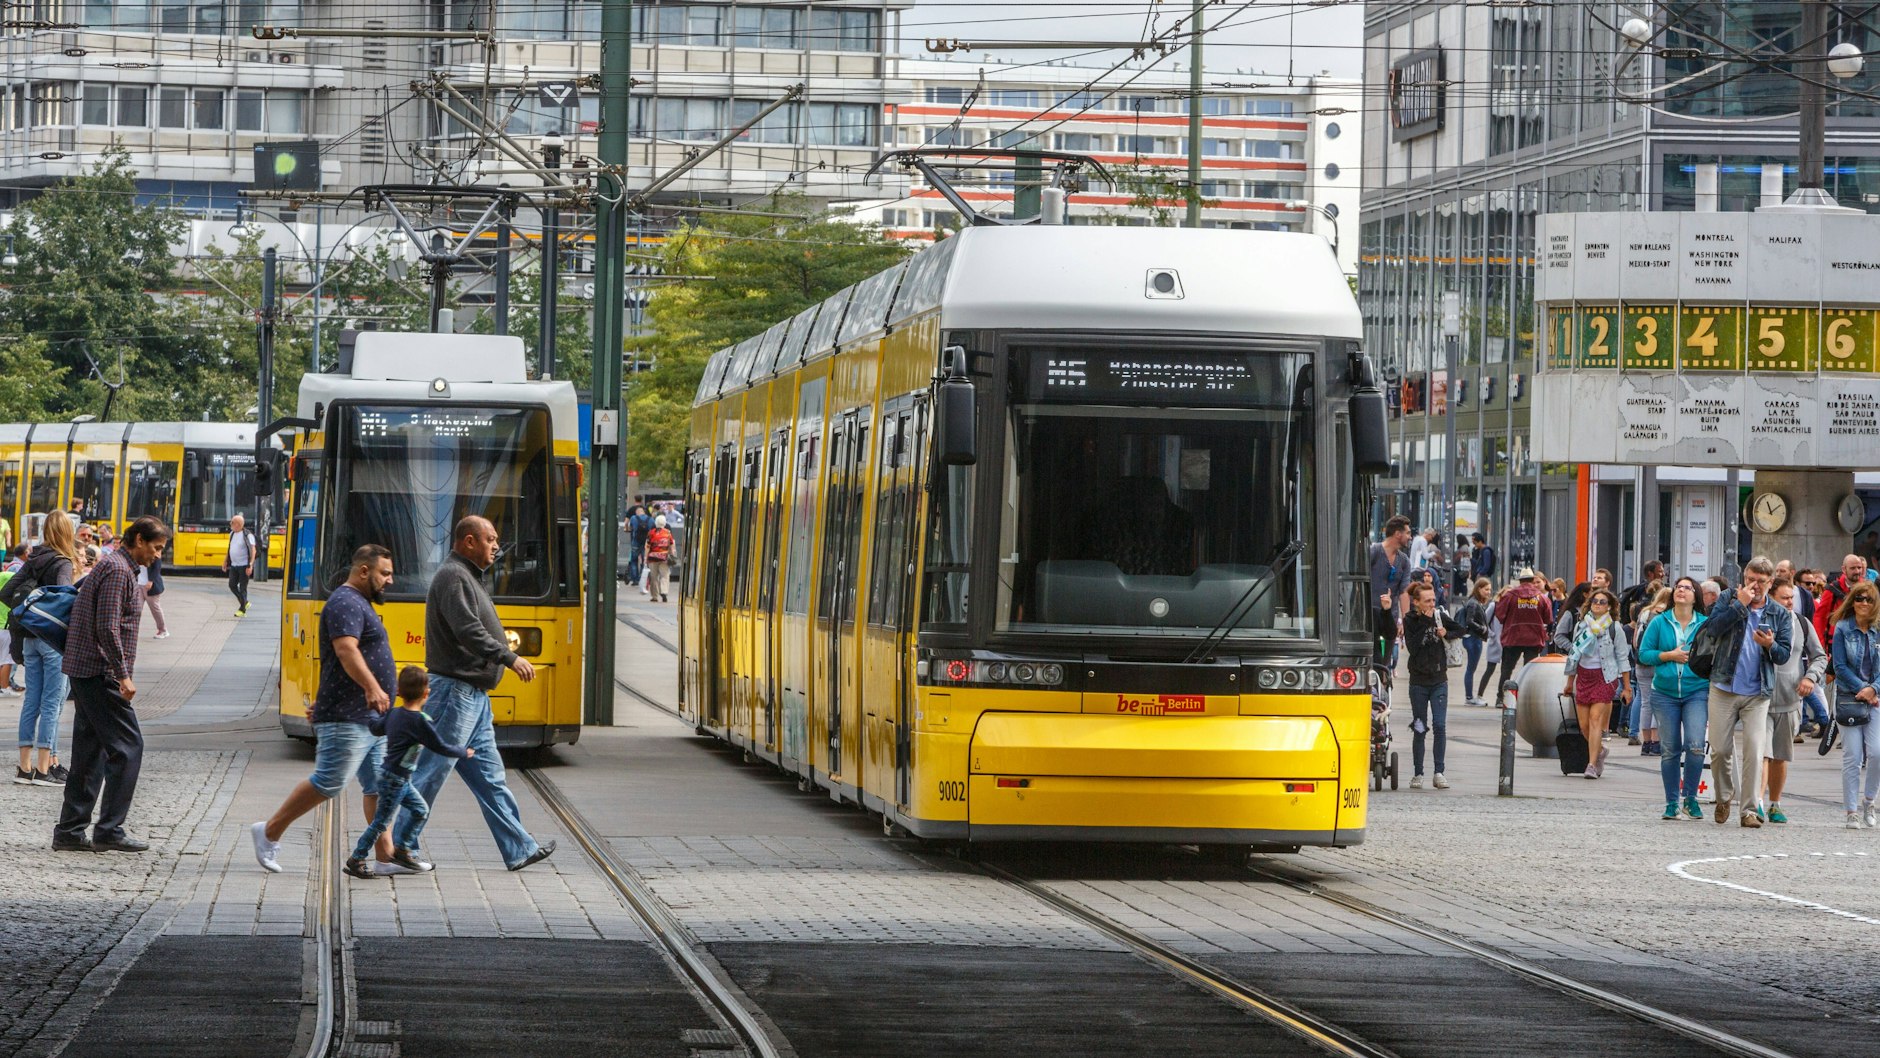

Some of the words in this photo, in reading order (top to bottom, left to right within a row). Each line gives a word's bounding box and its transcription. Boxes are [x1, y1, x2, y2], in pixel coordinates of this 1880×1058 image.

[1563, 317, 1572, 356] 1
[1588, 316, 1609, 356] 2
[1635, 316, 1658, 357] 3
[1687, 317, 1718, 357] 4
[1758, 318, 1786, 358] 5
[1826, 318, 1856, 359] 6
[1630, 423, 1662, 431] MANAGUA
[1763, 416, 1801, 425] ASUNCIÓN
[1624, 431, 1658, 440] GALÁPAGOS
[406, 631, 422, 645] be
[1116, 694, 1140, 713] be
[1167, 697, 1201, 710] Berlin
[938, 780, 966, 802] 9002
[1343, 788, 1361, 808] 9002
